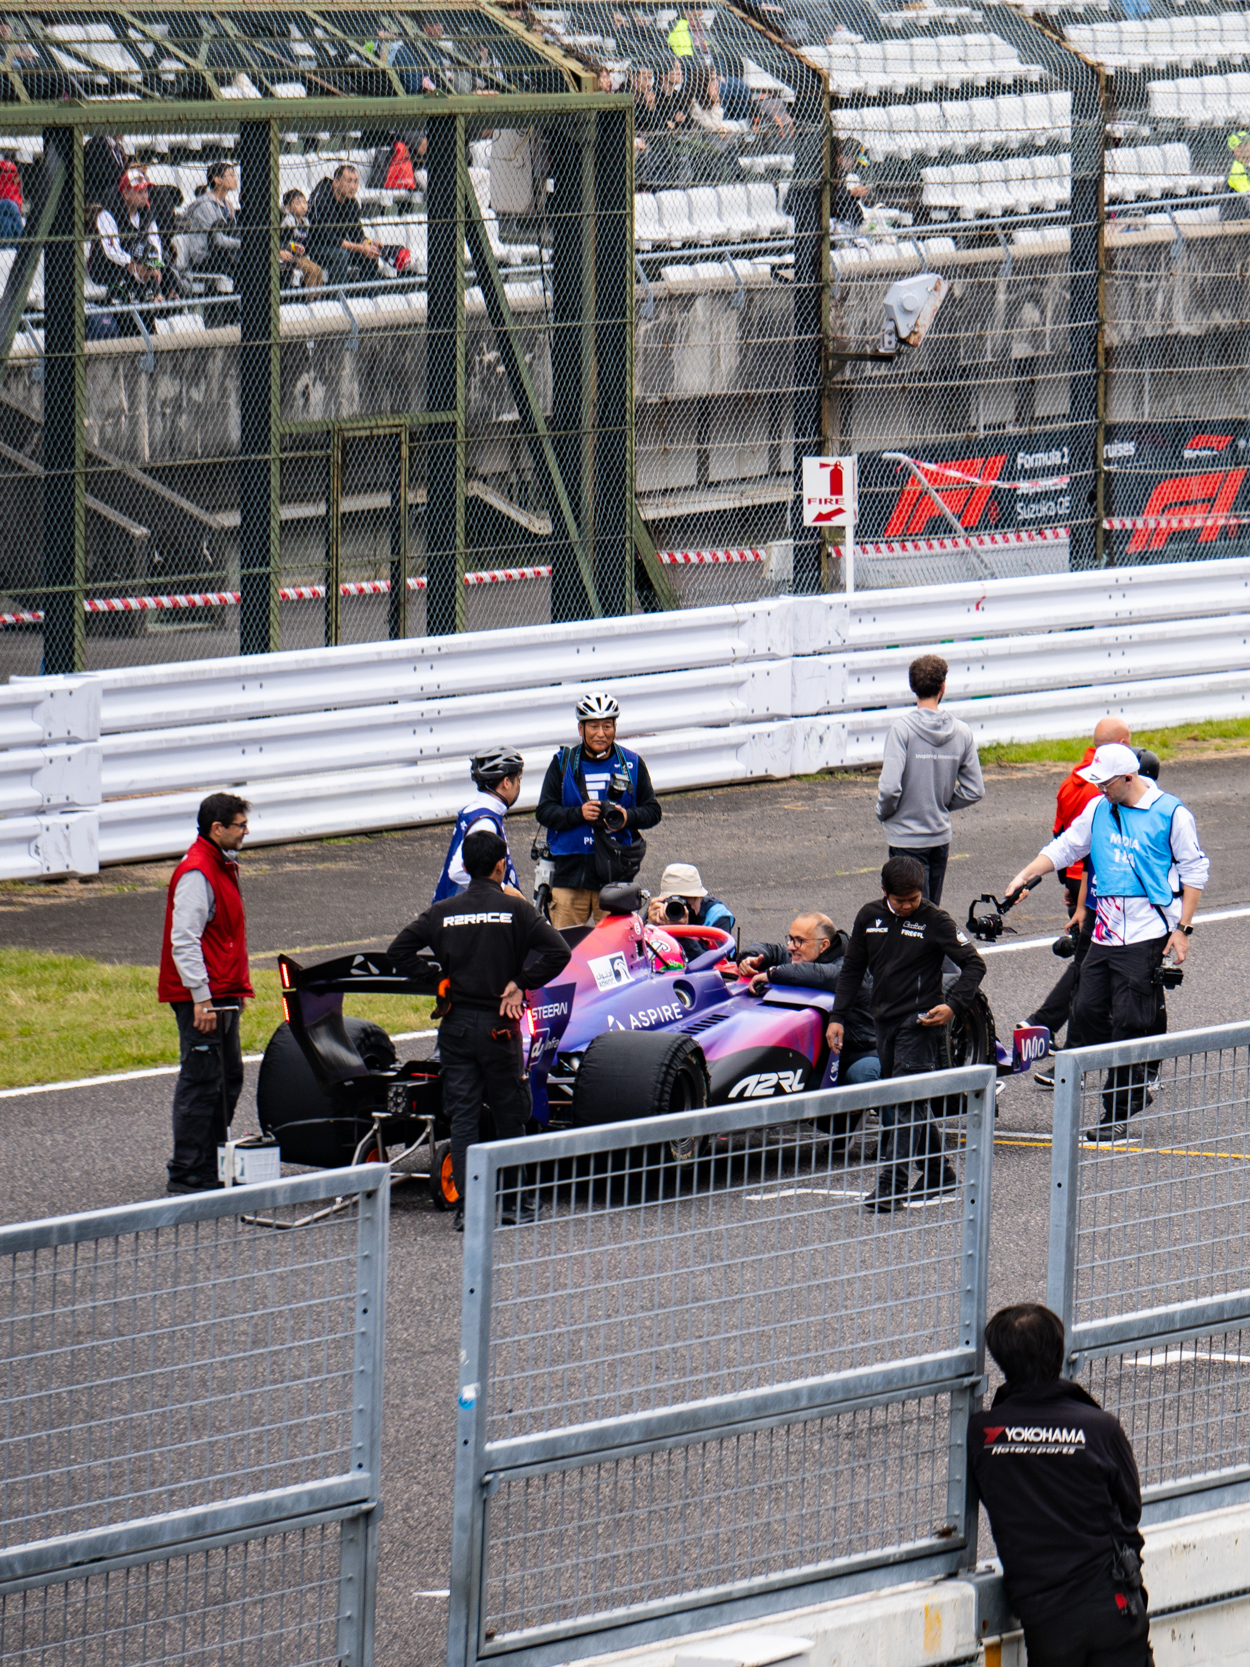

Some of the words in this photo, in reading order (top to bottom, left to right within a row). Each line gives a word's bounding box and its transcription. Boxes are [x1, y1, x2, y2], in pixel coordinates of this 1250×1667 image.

[1103, 439, 1136, 459] ruises
[807, 497, 846, 506] FIRE
[1110, 833, 1140, 851] MDIA
[443, 912, 513, 928] R2RACE
[629, 1002, 683, 1030] ASPIRE
[728, 1068, 806, 1099] A2RL
[1005, 1426, 1086, 1444] YOKOHAMA
[991, 1445, 1077, 1456] Motorsports
